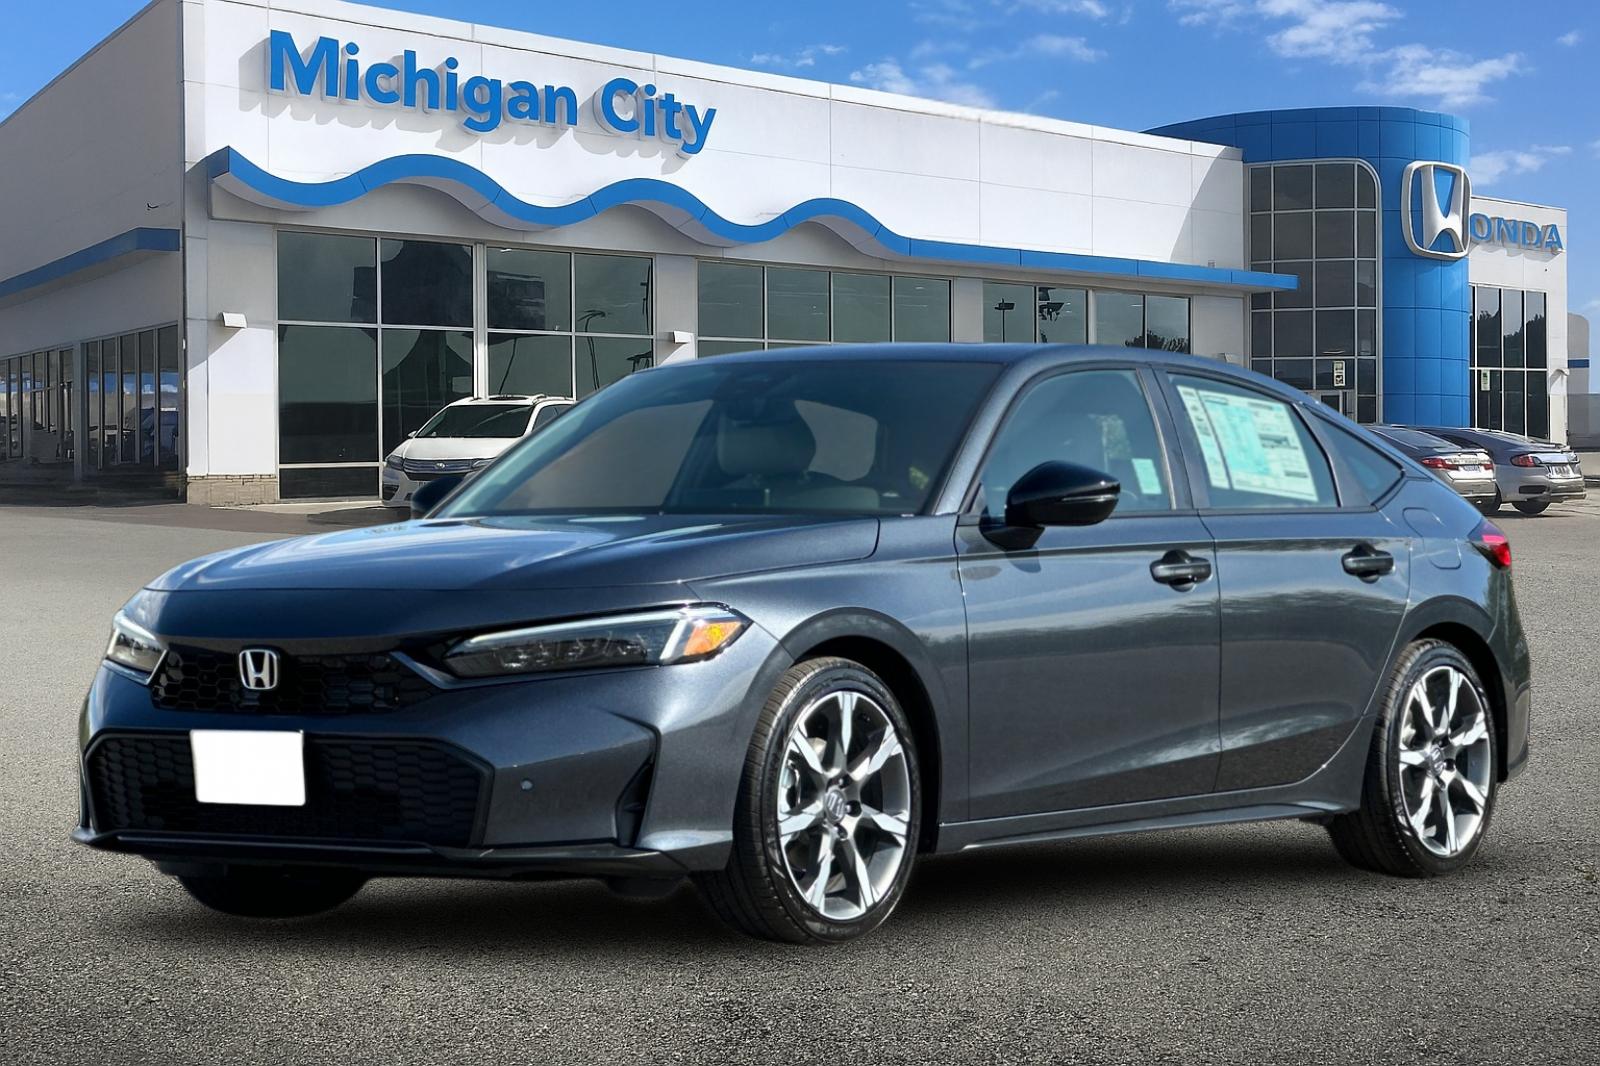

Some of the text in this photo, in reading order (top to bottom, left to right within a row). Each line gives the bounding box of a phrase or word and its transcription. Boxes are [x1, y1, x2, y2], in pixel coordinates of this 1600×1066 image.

[269, 28, 717, 154] Michigan City
[1469, 212, 1564, 250] ONDA
